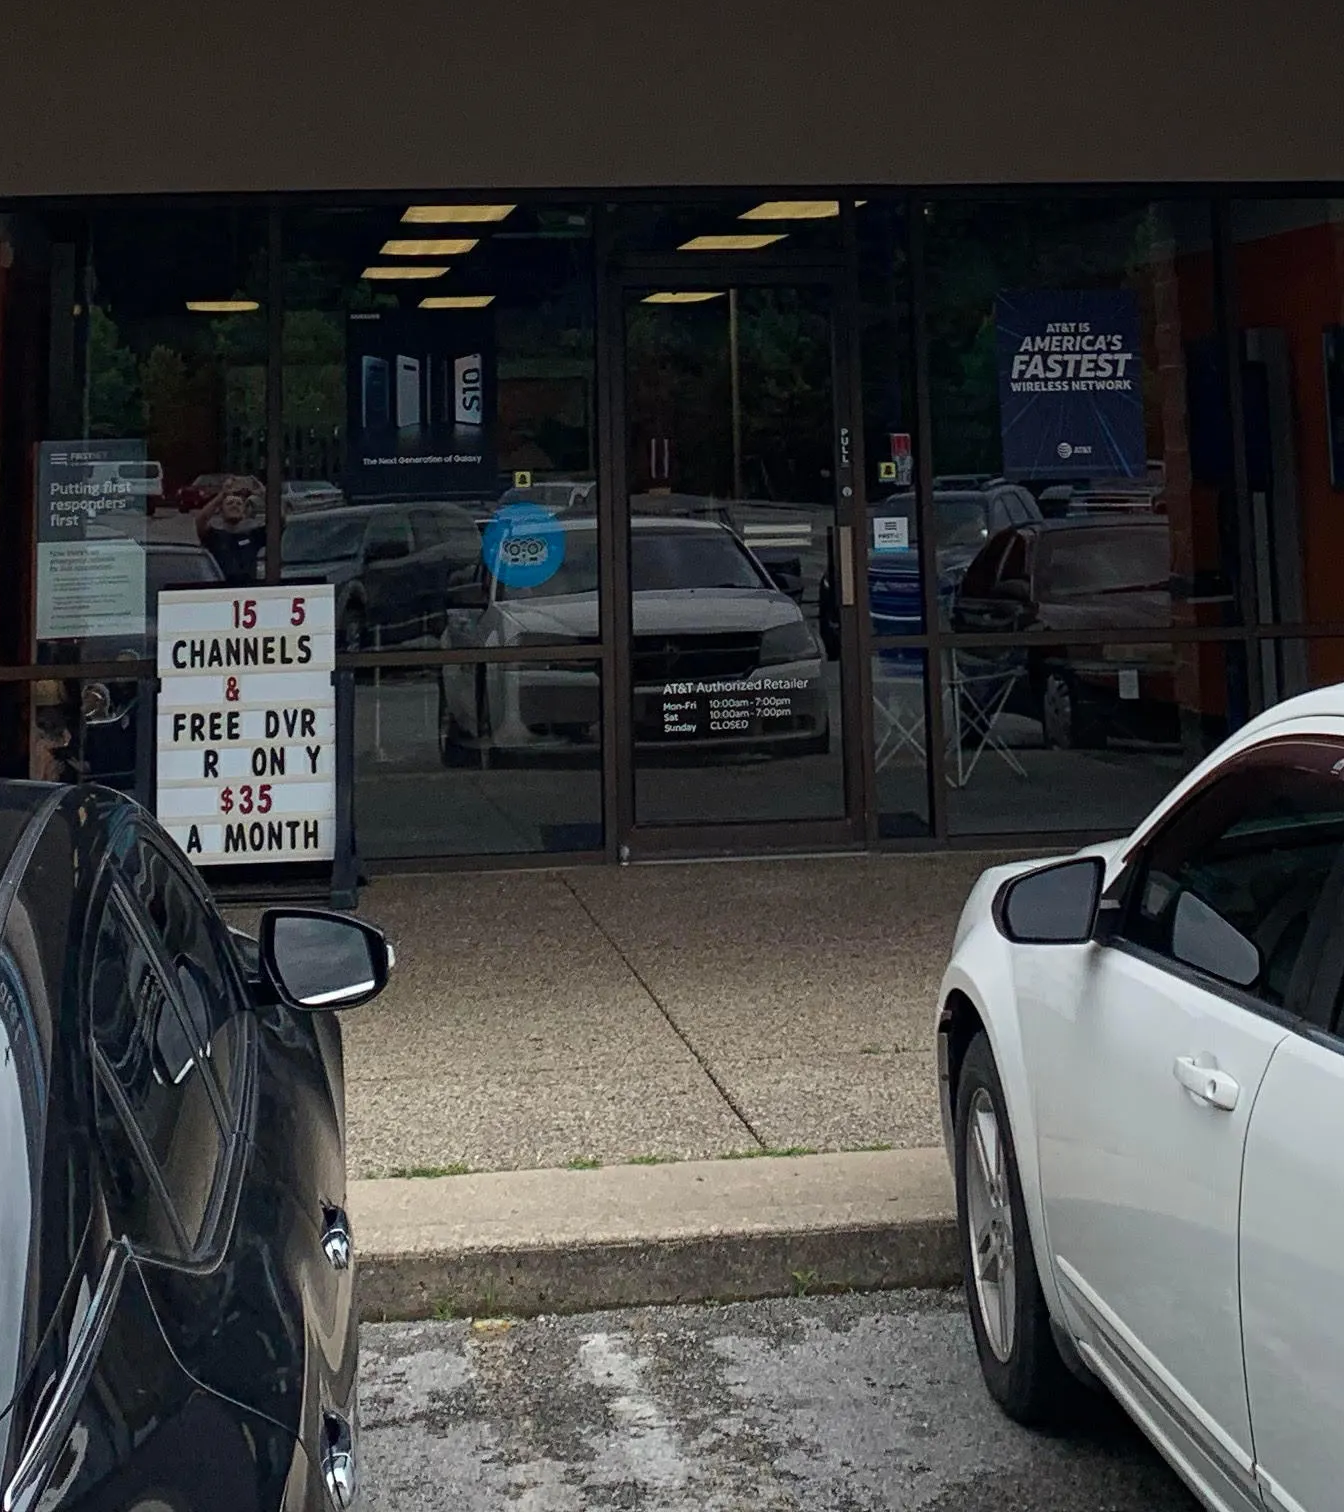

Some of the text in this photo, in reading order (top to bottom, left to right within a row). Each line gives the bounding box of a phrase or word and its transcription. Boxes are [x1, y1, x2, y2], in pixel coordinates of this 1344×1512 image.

[1046, 322, 1090, 333] AT&T IS
[1020, 335, 1123, 352] AMERICA'S
[1011, 353, 1133, 379] FASTEST
[462, 367, 481, 412] S10
[1011, 380, 1132, 392] WIRELESS NETWORK
[840, 428, 849, 464] PULL
[362, 458, 378, 466] The
[444, 454, 454, 463] of
[454, 454, 482, 463] Galaxy
[50, 480, 132, 496] Putting first
[50, 497, 126, 513] responders
[50, 514, 79, 527] first
[232, 598, 306, 629] 15 5
[172, 635, 312, 669] CHANNELS
[225, 676, 240, 701] &
[663, 678, 808, 695] AT&T Authorized Retailer
[663, 701, 697, 711] Mon-Fri
[173, 708, 316, 742] FREE DVR
[664, 713, 679, 722] Sat
[710, 720, 749, 730] CLOSED
[664, 723, 697, 733] Sunday
[203, 749, 219, 778] R
[220, 784, 273, 815] $35
[187, 819, 319, 854] A MONTH
